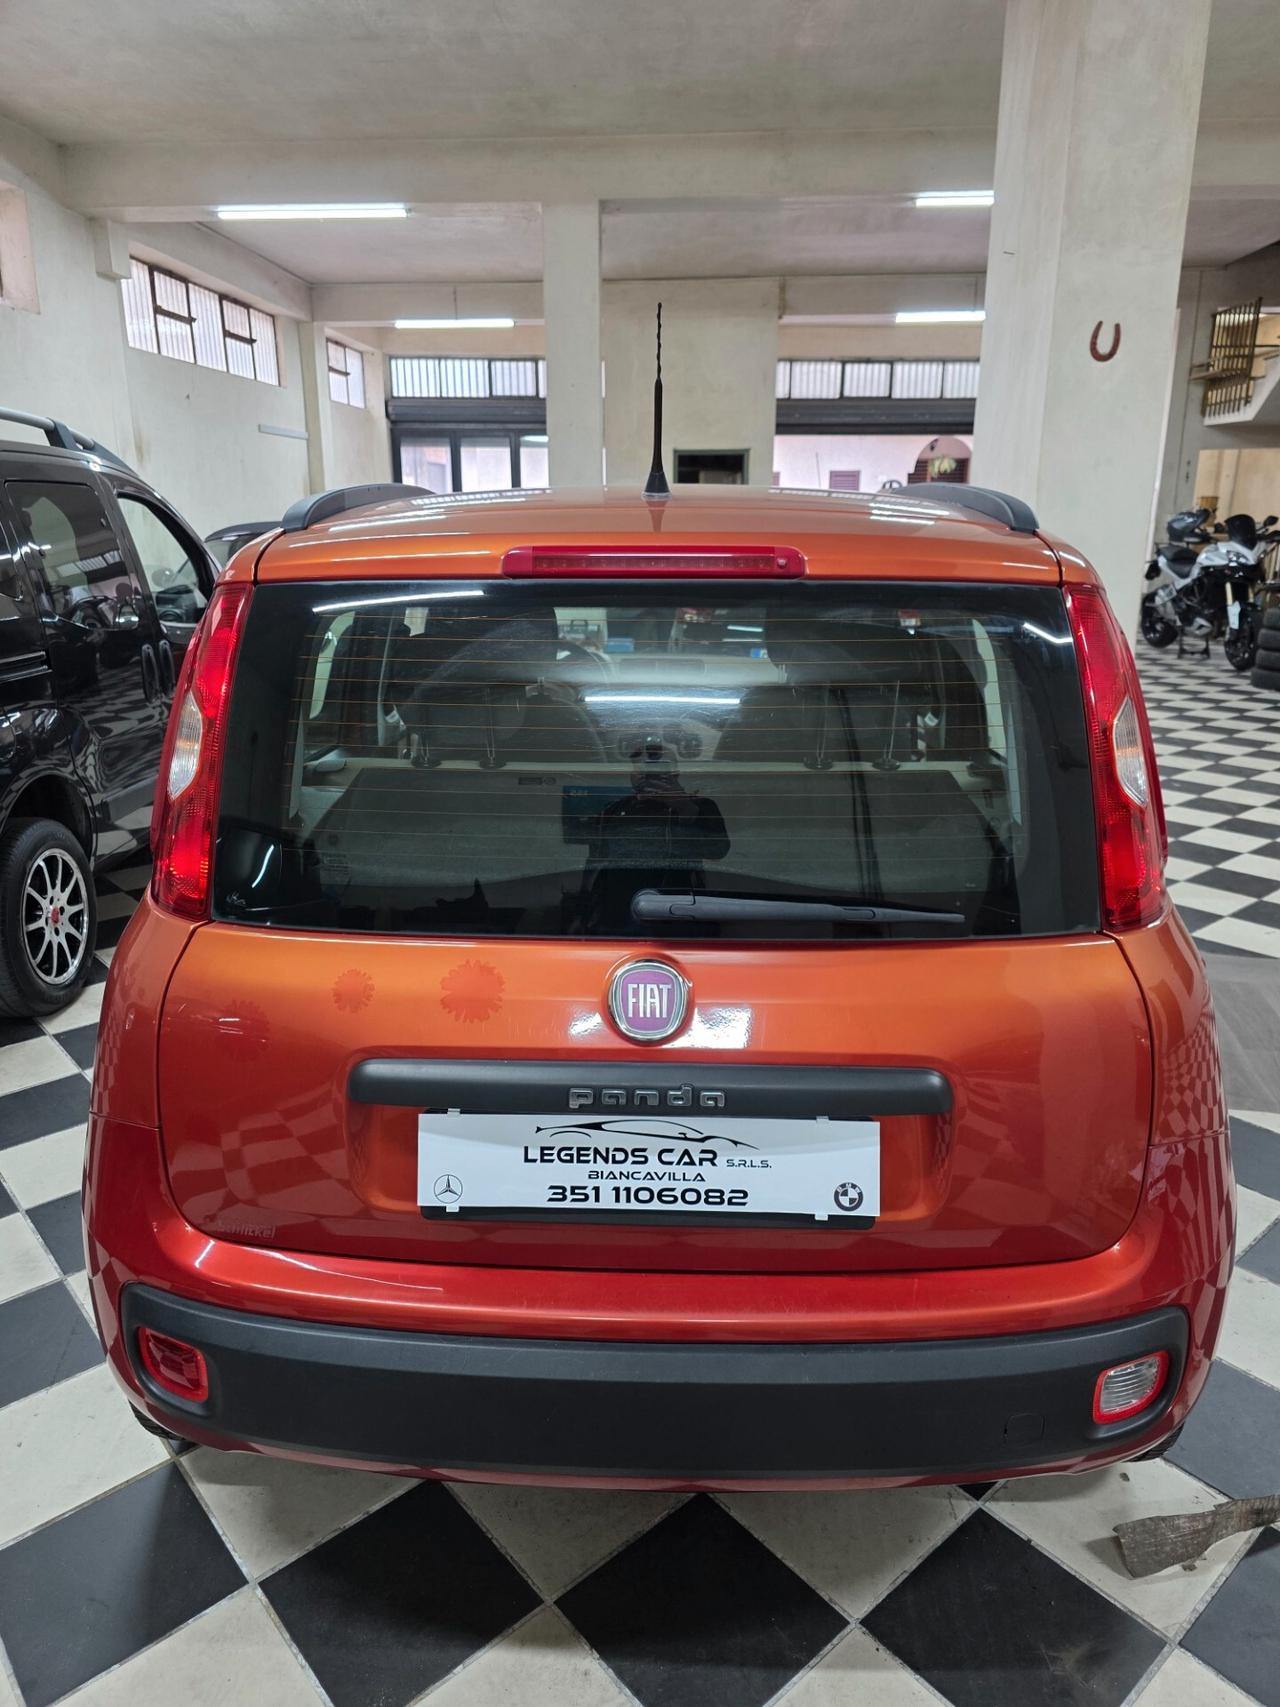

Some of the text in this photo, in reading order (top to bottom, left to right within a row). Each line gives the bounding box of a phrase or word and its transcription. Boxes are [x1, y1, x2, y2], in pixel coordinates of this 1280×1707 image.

[627, 983, 672, 1018] FIAT
[568, 1085, 725, 1109] panda
[523, 1145, 772, 1169] LEGENDS CAR S.R.L.S.
[587, 1170, 706, 1183] BIANCAVILLA
[546, 1184, 749, 1207] 351 1106082
